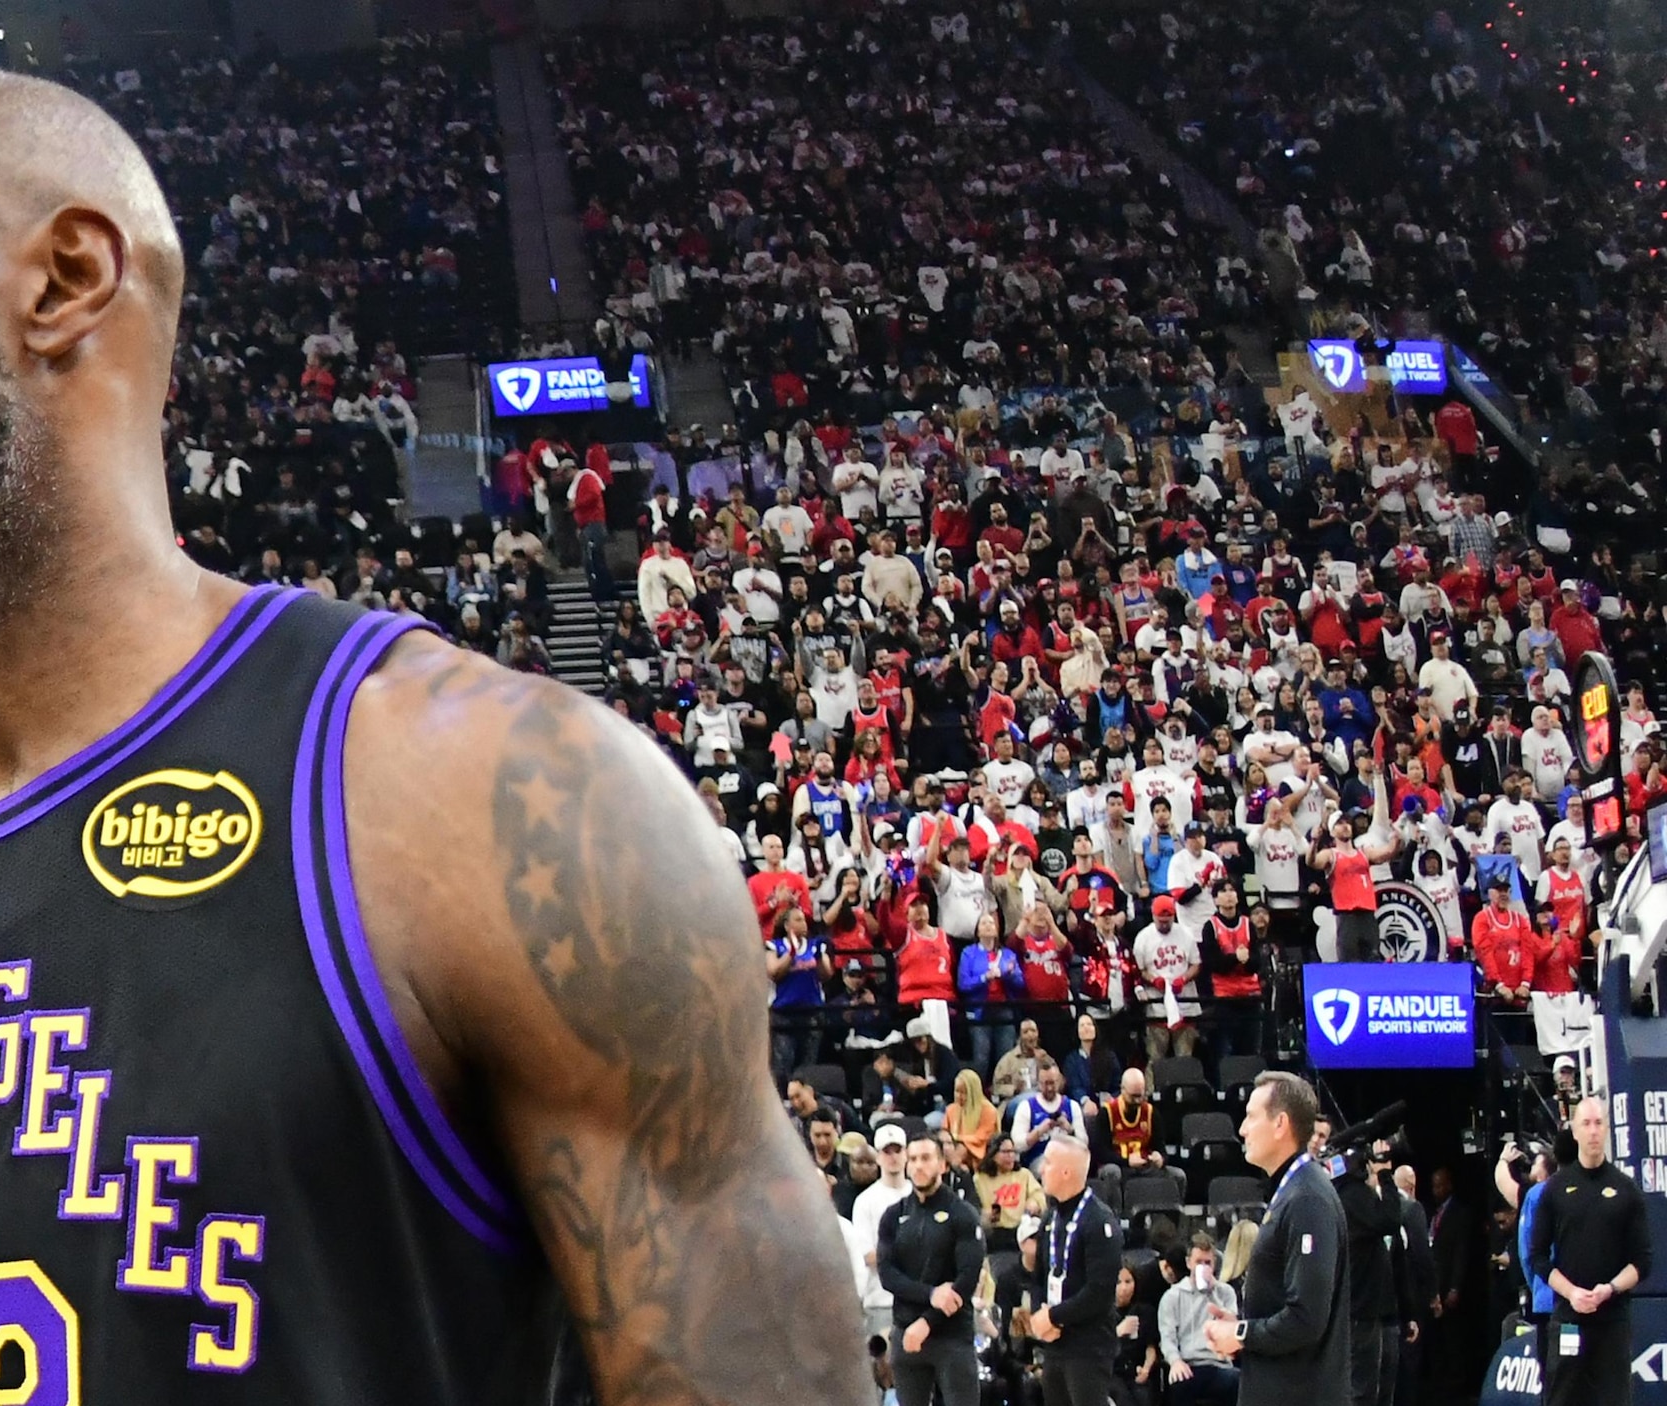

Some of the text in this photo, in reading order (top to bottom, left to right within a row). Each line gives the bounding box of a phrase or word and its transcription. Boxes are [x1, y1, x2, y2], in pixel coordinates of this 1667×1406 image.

[100, 801, 250, 858] bibigo
[121, 846, 184, 868] 비비고
[1368, 995, 1467, 1018] FANDUEL
[1368, 1019, 1467, 1035] SPORTS NETWORK
[1644, 1090, 1667, 1123] GE
[1646, 1124, 1667, 1157] TH
